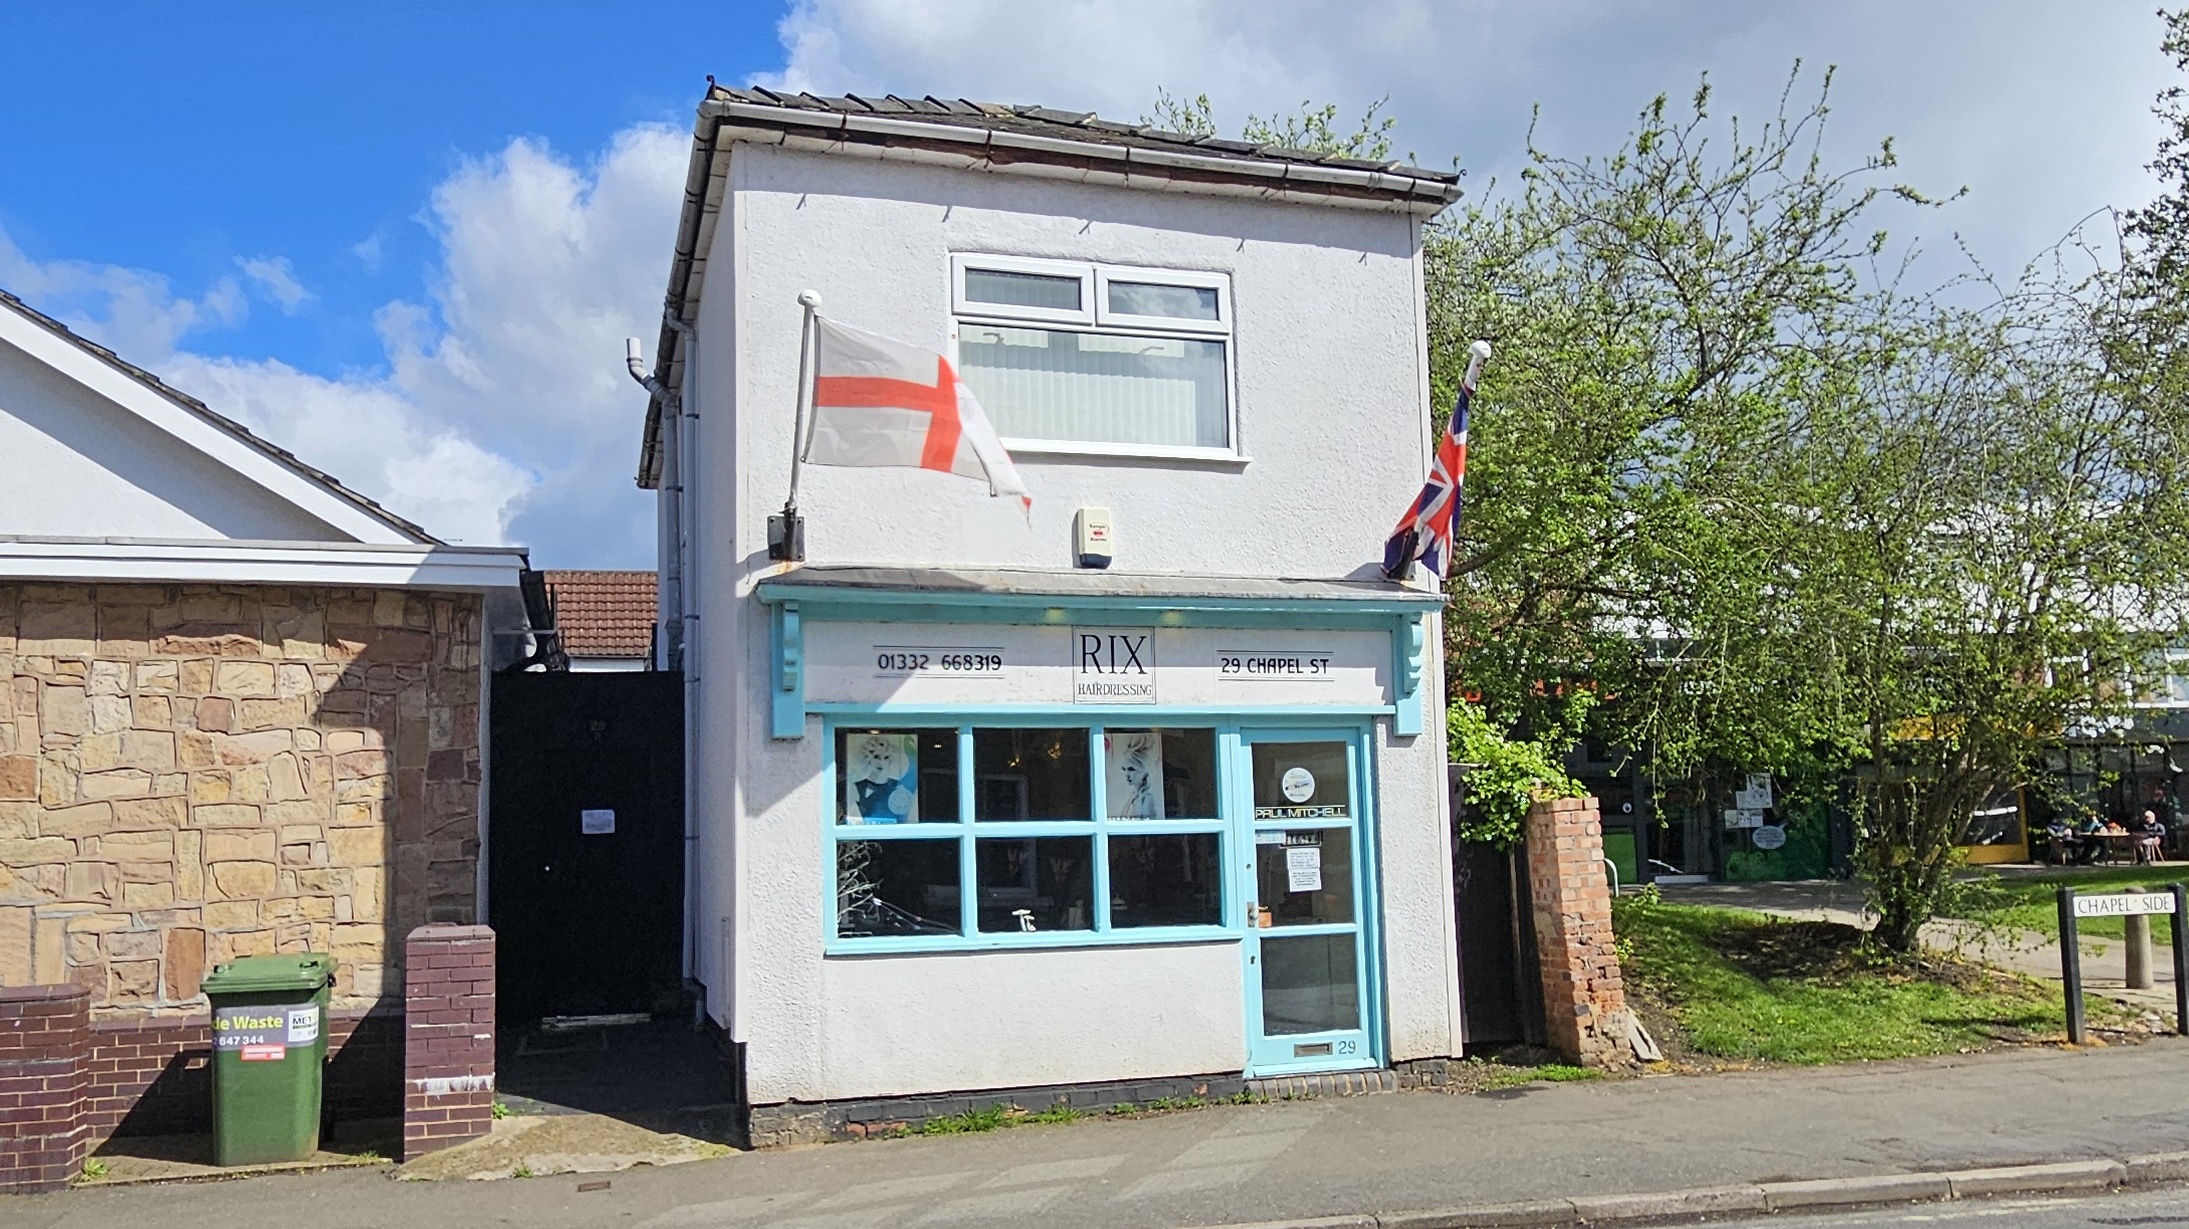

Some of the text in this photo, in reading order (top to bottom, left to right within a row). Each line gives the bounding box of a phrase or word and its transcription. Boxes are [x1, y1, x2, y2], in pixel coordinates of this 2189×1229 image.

[1079, 634, 1148, 675] RIX
[878, 654, 1002, 671] 01332 668319
[1221, 657, 1330, 675] 29 CHAPEL ST
[1078, 682, 1152, 696] HAIRDRESSING
[1255, 806, 1347, 819] PAUL MITCHELL
[2077, 896, 2170, 914] CHAPEL SIDE
[232, 1016, 284, 1030] Waste
[219, 1036, 241, 1046] 647
[242, 1035, 264, 1045] 344
[1338, 1040, 1356, 1055] 29
